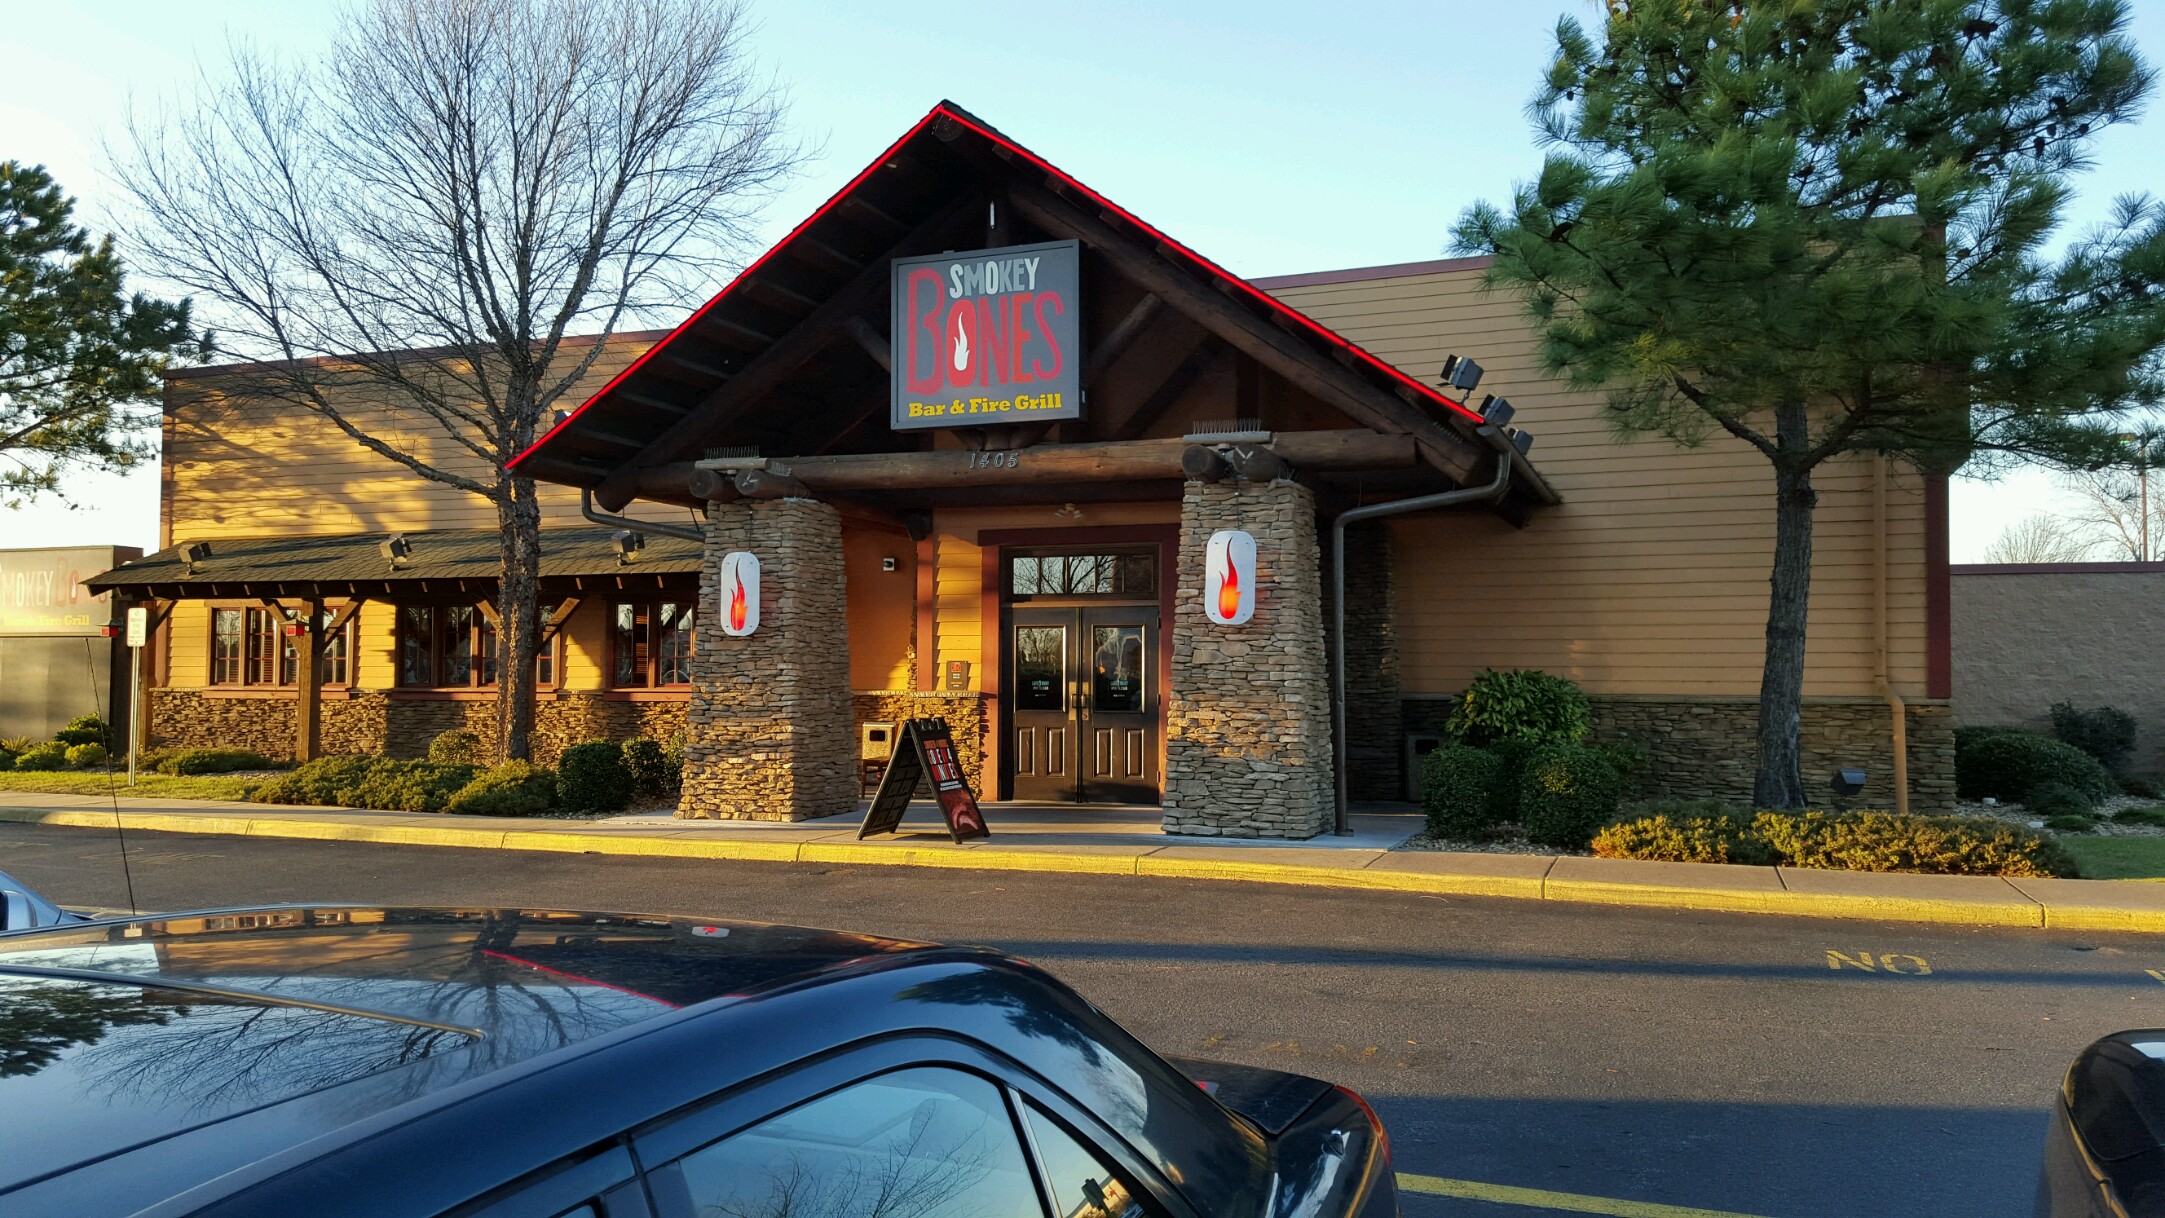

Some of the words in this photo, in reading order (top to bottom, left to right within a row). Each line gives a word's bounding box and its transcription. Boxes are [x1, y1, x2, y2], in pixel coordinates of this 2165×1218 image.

[949, 257, 1040, 299] SMOKEY
[906, 268, 1064, 396] BONES
[908, 403, 945, 417] Bar
[950, 399, 965, 415] &
[969, 397, 1011, 414] Fire
[1014, 393, 1062, 410] Grill
[970, 452, 1019, 468] 1405
[0, 560, 54, 607] MOKEY
[64, 613, 90, 626] Grill
[1826, 950, 1934, 976] NO
